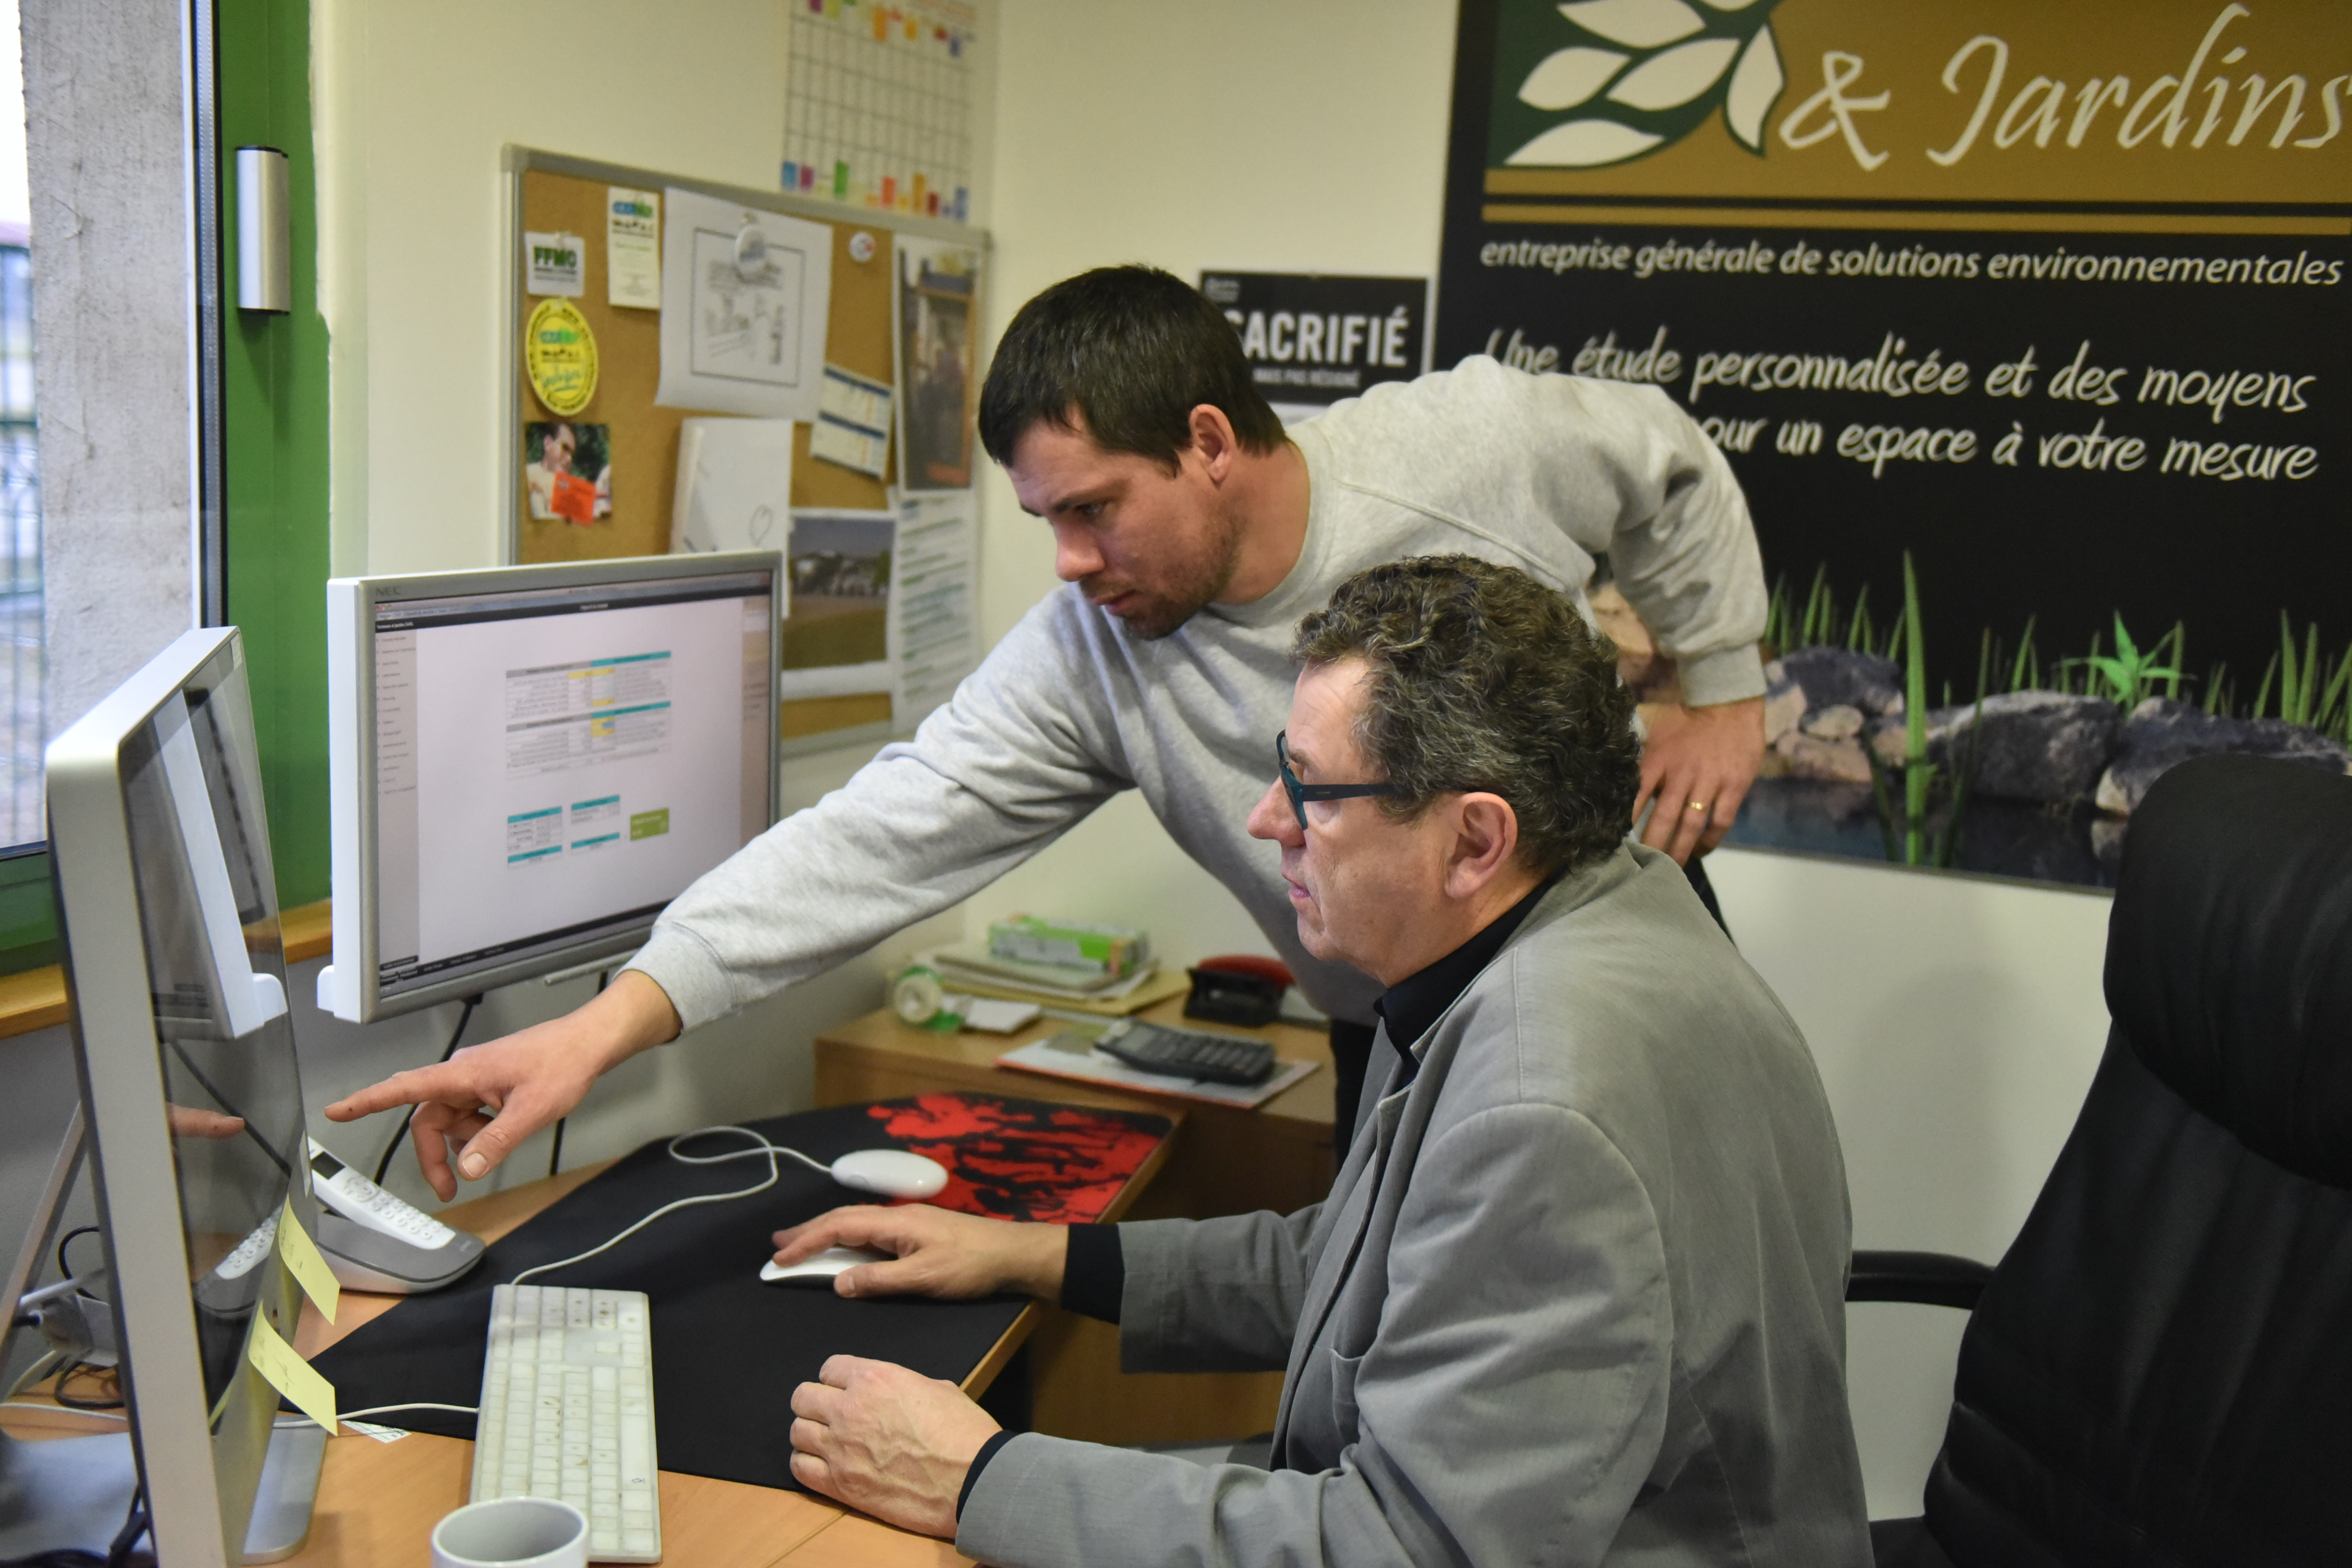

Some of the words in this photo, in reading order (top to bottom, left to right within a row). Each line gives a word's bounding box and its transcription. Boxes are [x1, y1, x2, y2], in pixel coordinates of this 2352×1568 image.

[1778, 50, 1892, 171] &
[1926, 2, 2352, 167] Jardins
[1480, 237, 1632, 275] entreprise
[1634, 238, 1776, 279] générale
[1779, 240, 1822, 275] de
[1827, 242, 1981, 279] solutions
[1986, 246, 2344, 286] environnementales
[1485, 327, 1560, 375] Une
[1571, 324, 1683, 383] étude
[1688, 331, 1970, 403] personnalisée
[1984, 344, 2038, 398] et
[2047, 339, 2128, 406] des
[2137, 365, 2317, 424] moyens
[1701, 417, 1768, 454] our
[1775, 420, 1824, 456] un
[1836, 423, 1977, 479] espace
[1991, 420, 2024, 467] à
[2038, 417, 2147, 472] votre
[2160, 437, 2319, 482] mesure
